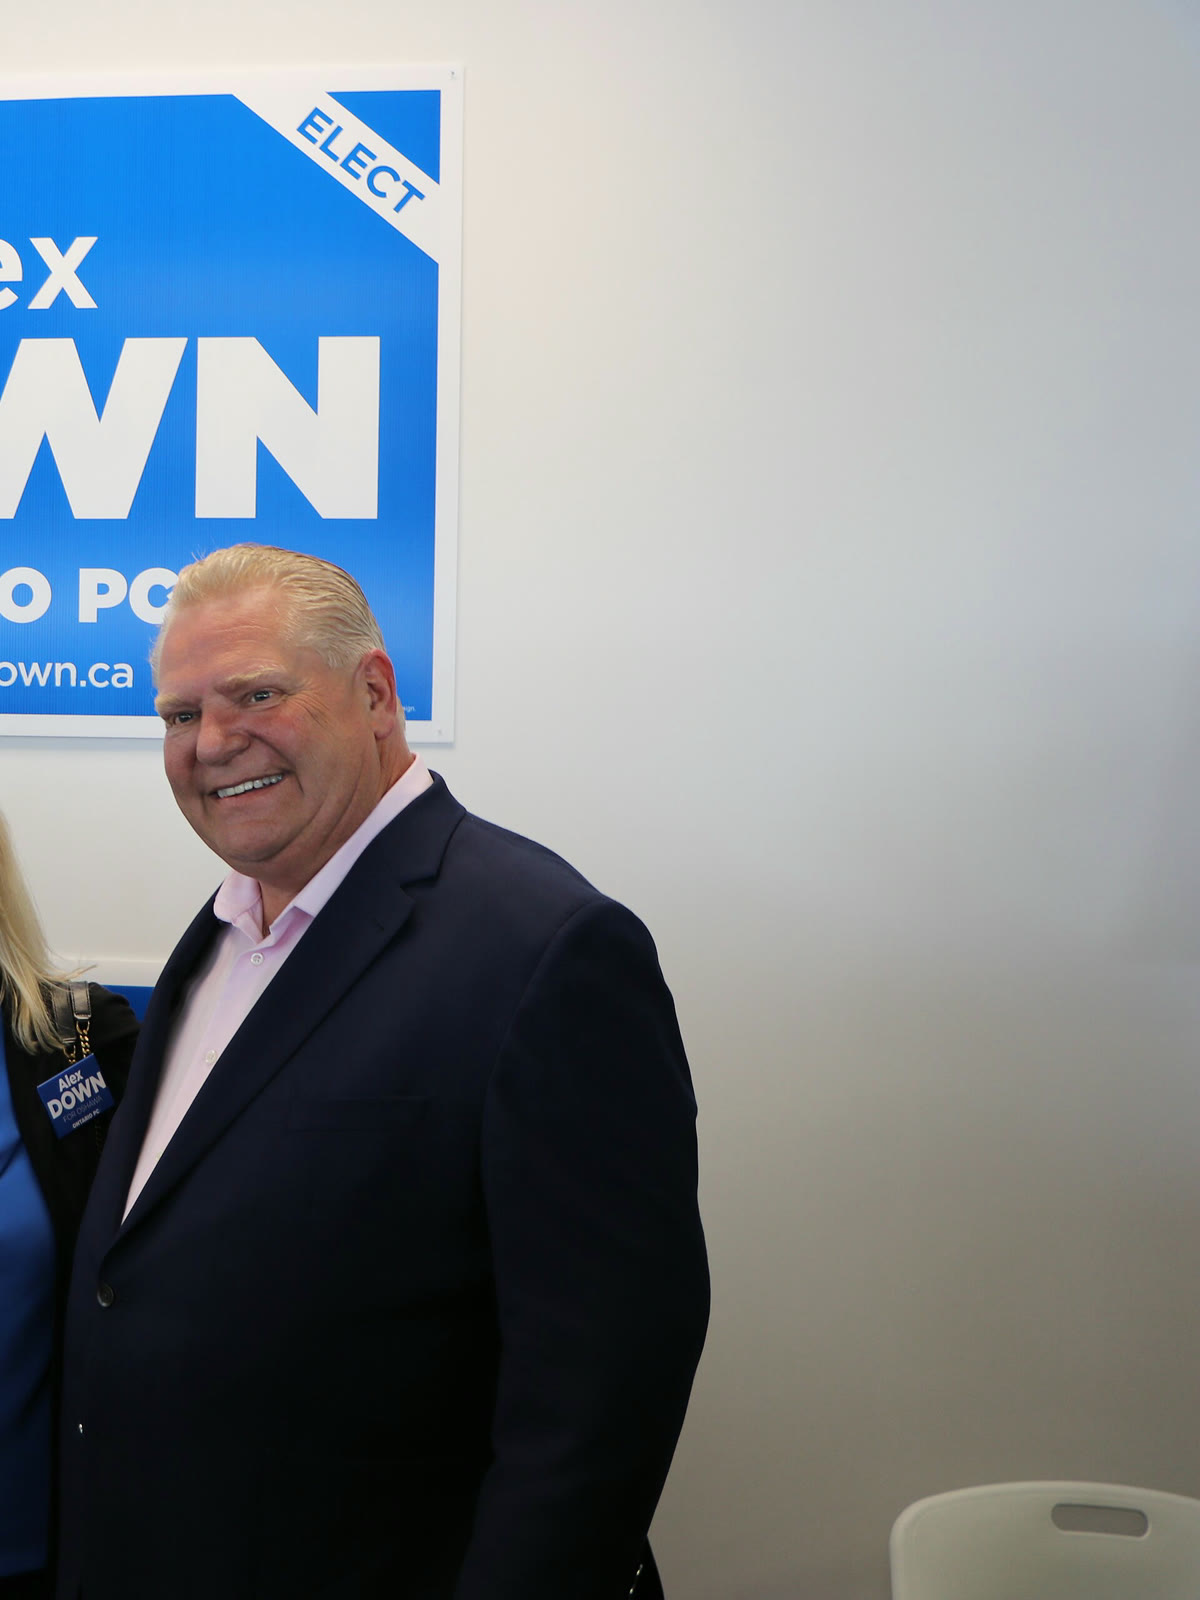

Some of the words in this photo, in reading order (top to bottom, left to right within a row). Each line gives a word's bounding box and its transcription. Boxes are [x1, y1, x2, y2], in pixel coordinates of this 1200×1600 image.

[296, 106, 426, 214] ELECT
[77, 566, 180, 625] PC
[46, 1071, 107, 1120] DOWN
[58, 1070, 84, 1092] Alex
[62, 1110, 77, 1122] FOR
[72, 1113, 94, 1129] ONTARIO
